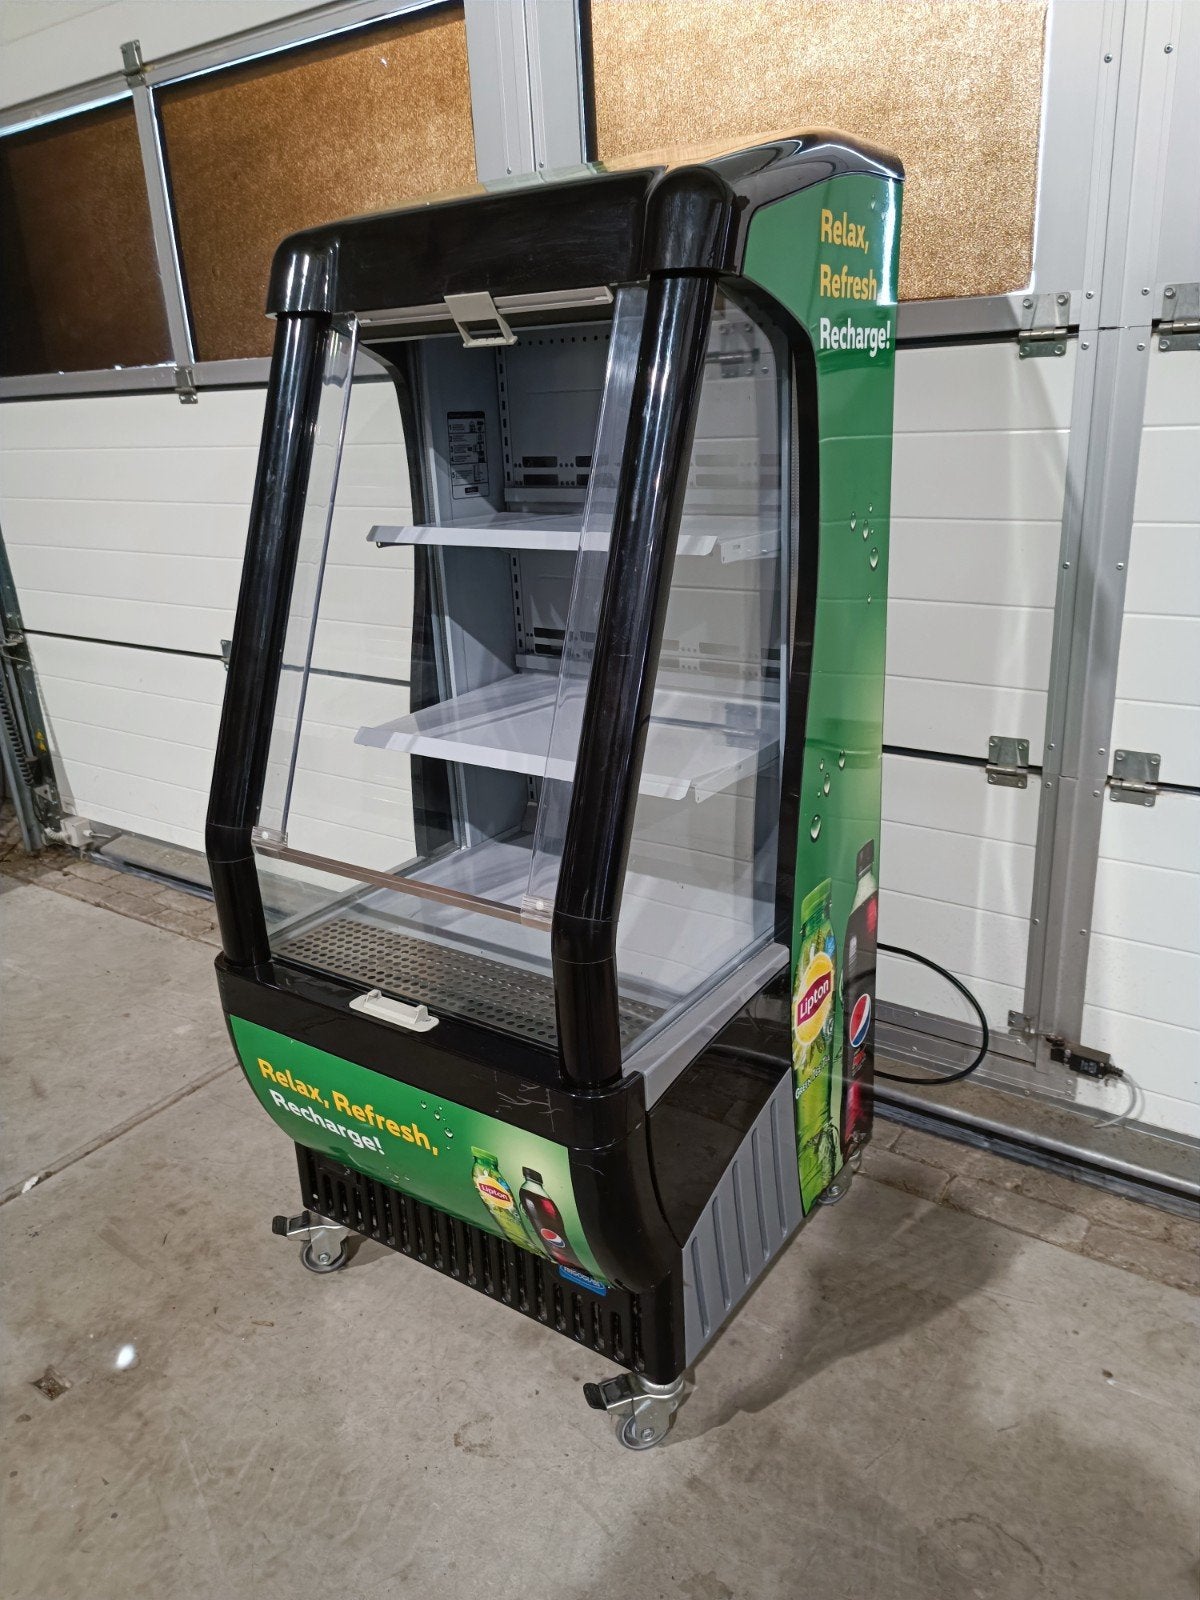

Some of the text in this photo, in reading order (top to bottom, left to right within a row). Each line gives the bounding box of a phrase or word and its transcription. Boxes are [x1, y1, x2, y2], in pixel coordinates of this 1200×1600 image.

[820, 208, 869, 254] Relax,
[820, 317, 891, 357] Recharge!
[800, 979, 829, 1020] Lipton
[257, 1058, 439, 1156] Relax, Refresh,
[269, 1089, 385, 1155] Recharge!
[480, 1184, 508, 1201] Lipton
